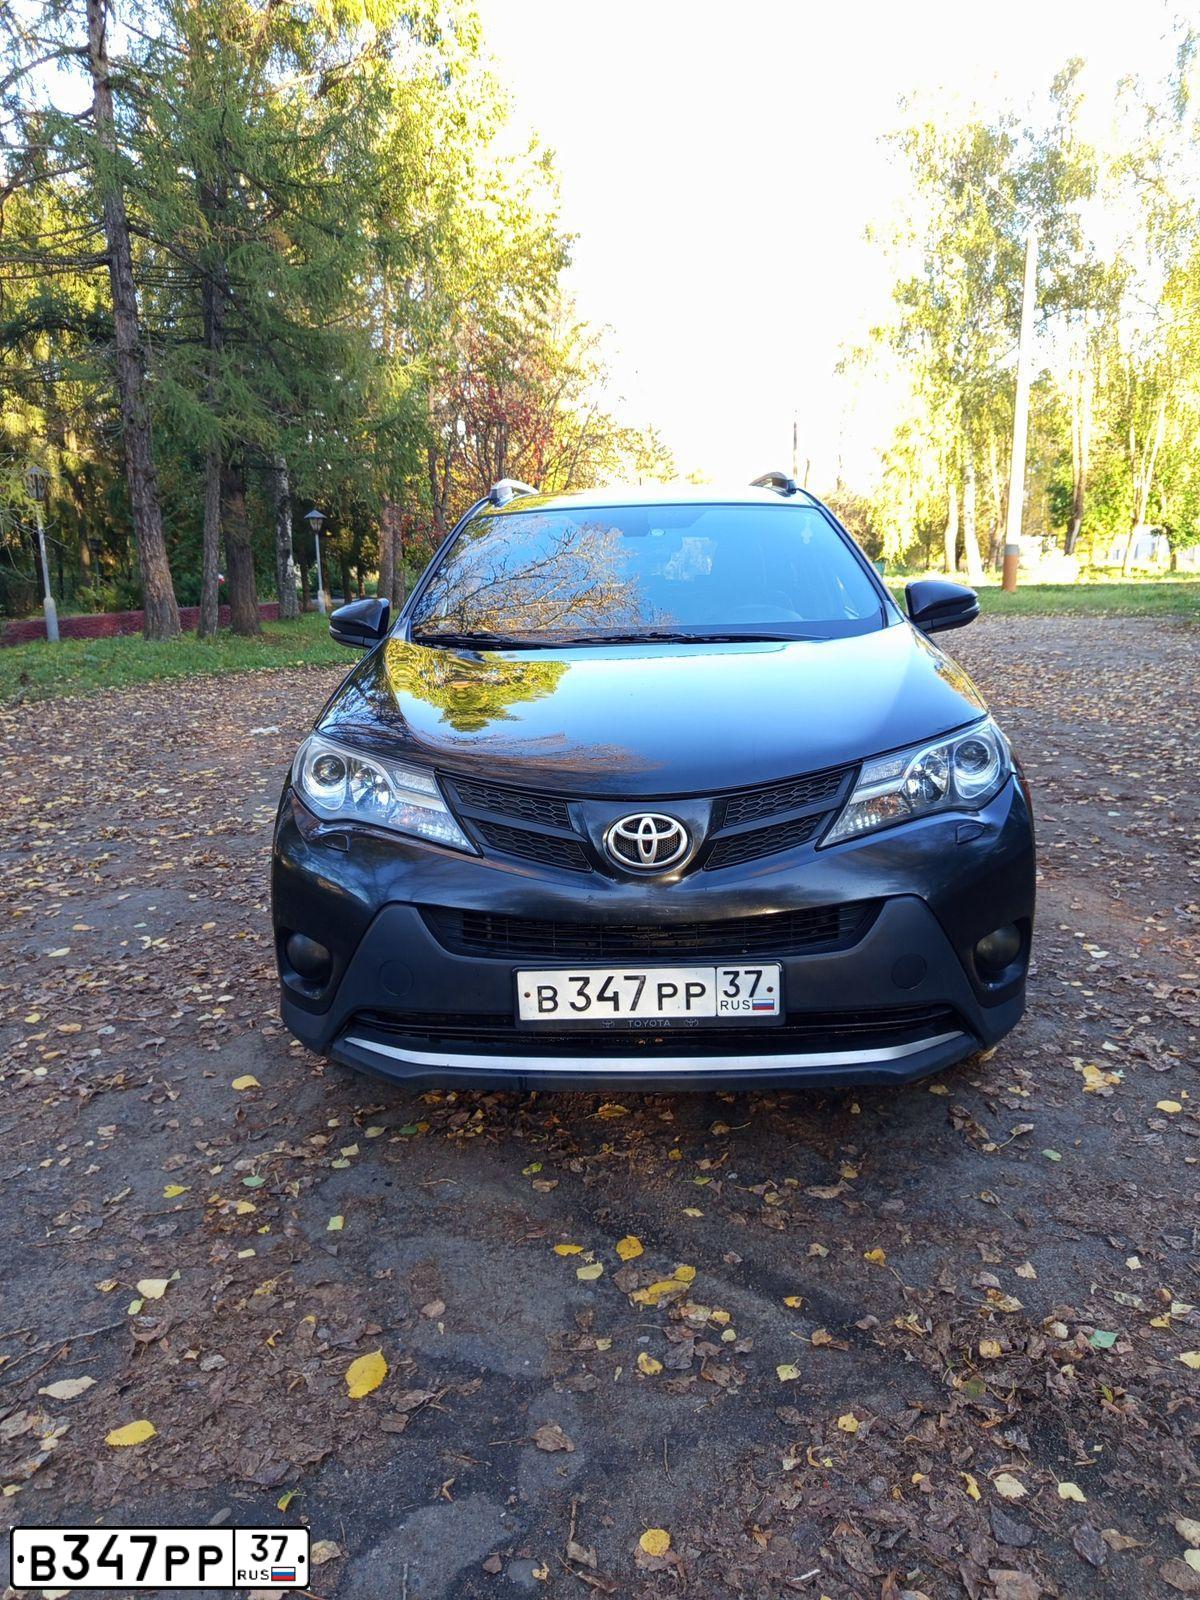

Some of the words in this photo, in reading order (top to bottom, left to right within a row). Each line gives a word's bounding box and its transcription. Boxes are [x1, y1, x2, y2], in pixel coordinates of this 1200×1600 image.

[722, 970, 763, 998] 37
[720, 999, 750, 1011] RUS
[627, 1019, 671, 1028] TOYOTA
